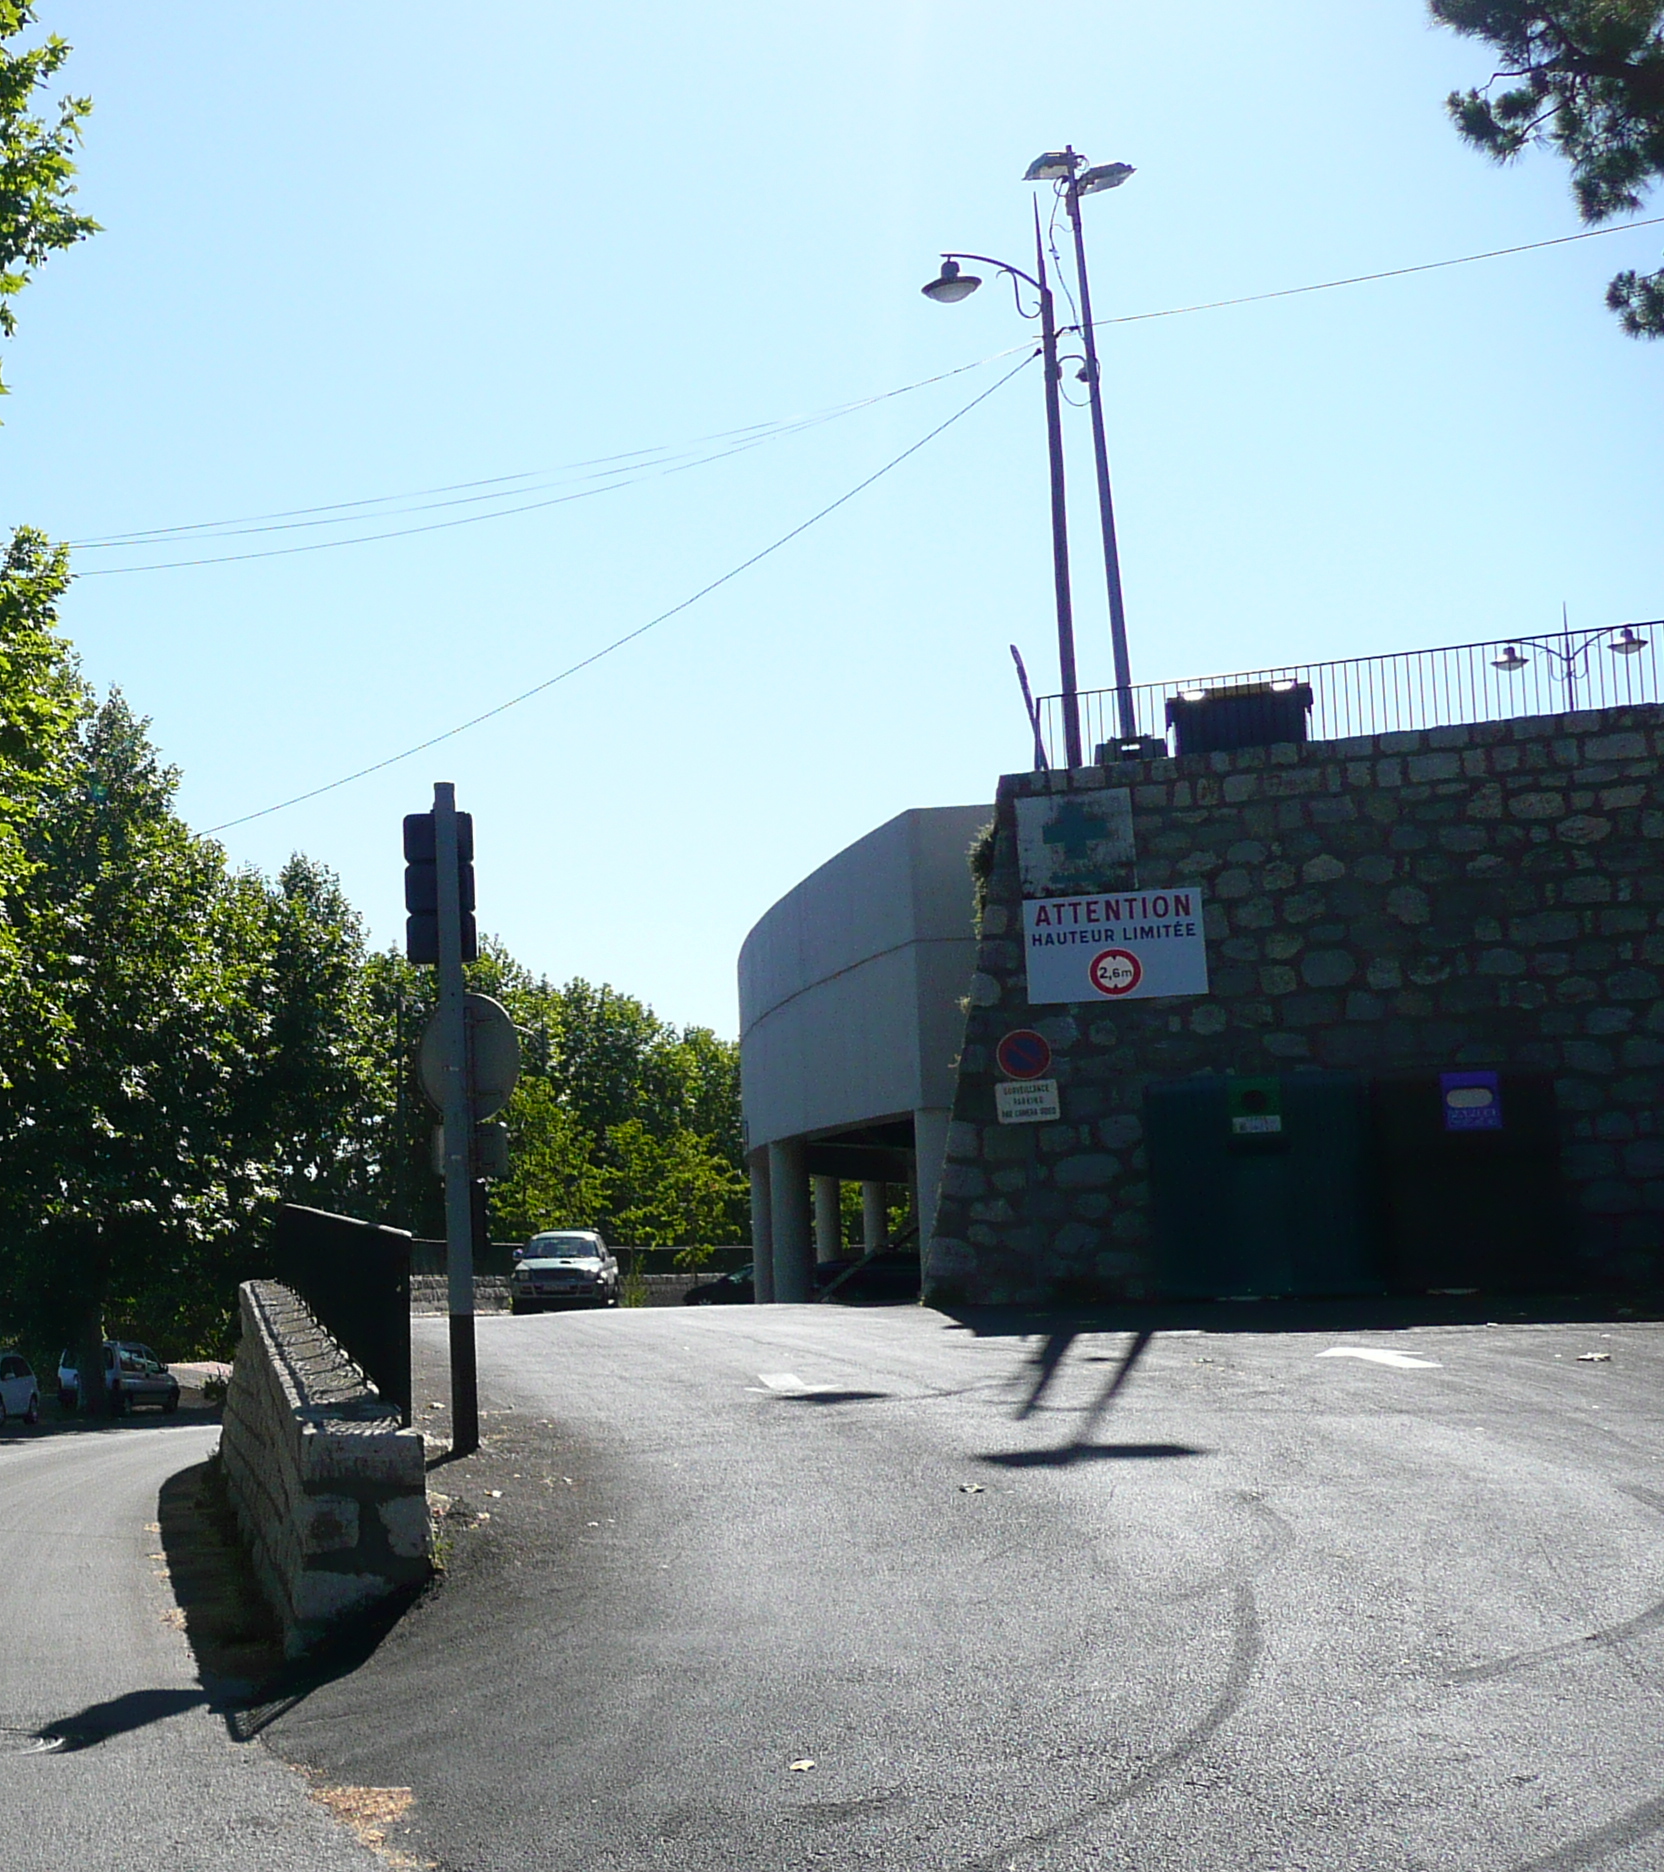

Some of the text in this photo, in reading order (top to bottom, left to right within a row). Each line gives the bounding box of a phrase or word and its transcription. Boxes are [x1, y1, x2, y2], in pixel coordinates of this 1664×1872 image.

[1035, 894, 1191, 926] ATTENTION
[1032, 921, 1196, 946] HAUTEUR LIMITÉE
